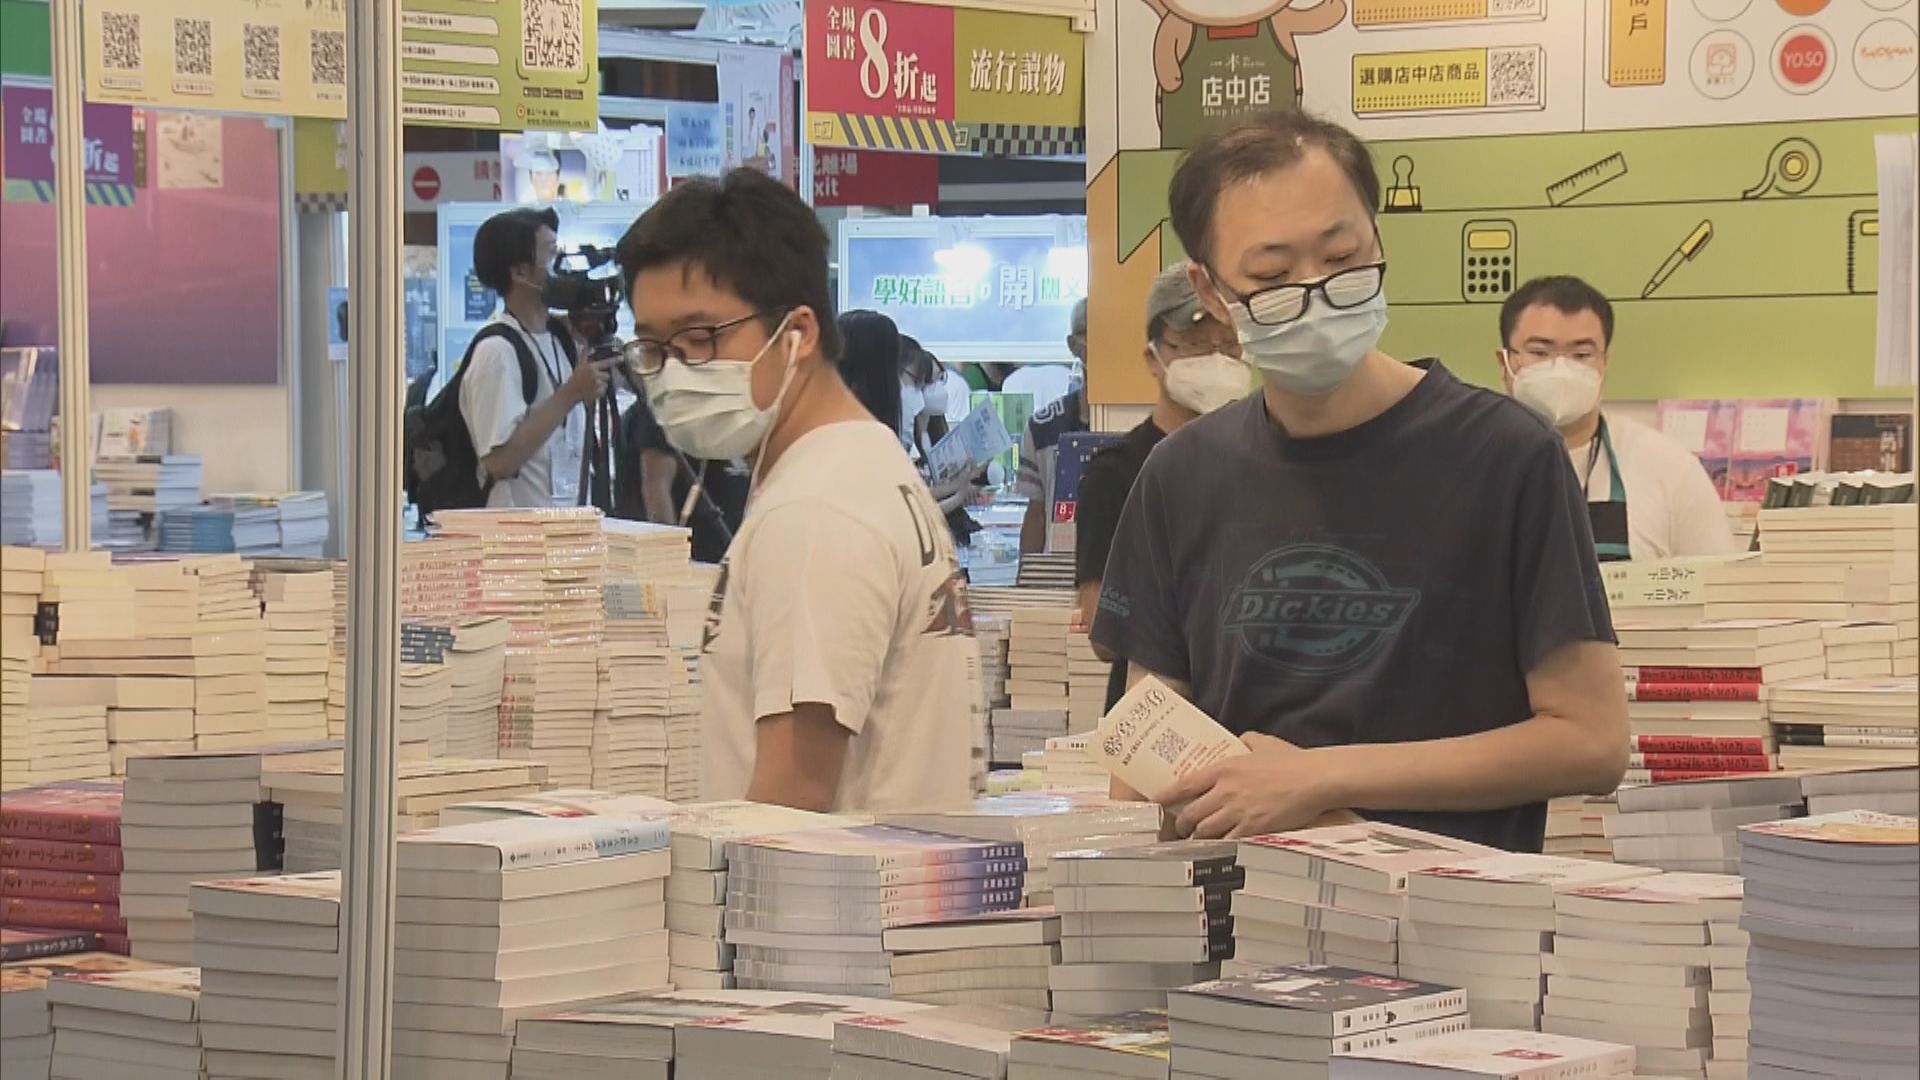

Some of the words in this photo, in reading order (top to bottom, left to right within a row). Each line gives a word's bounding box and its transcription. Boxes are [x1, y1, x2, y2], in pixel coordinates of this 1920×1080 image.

[828, 6, 855, 32] 全場
[826, 33, 855, 60] 圖書
[970, 49, 1065, 95] 流行讀物
[1360, 63, 1479, 86] 選購店中店商品
[1202, 73, 1270, 106] 店中店
[815, 177, 838, 196] xit
[1237, 594, 1393, 621] Dickies
